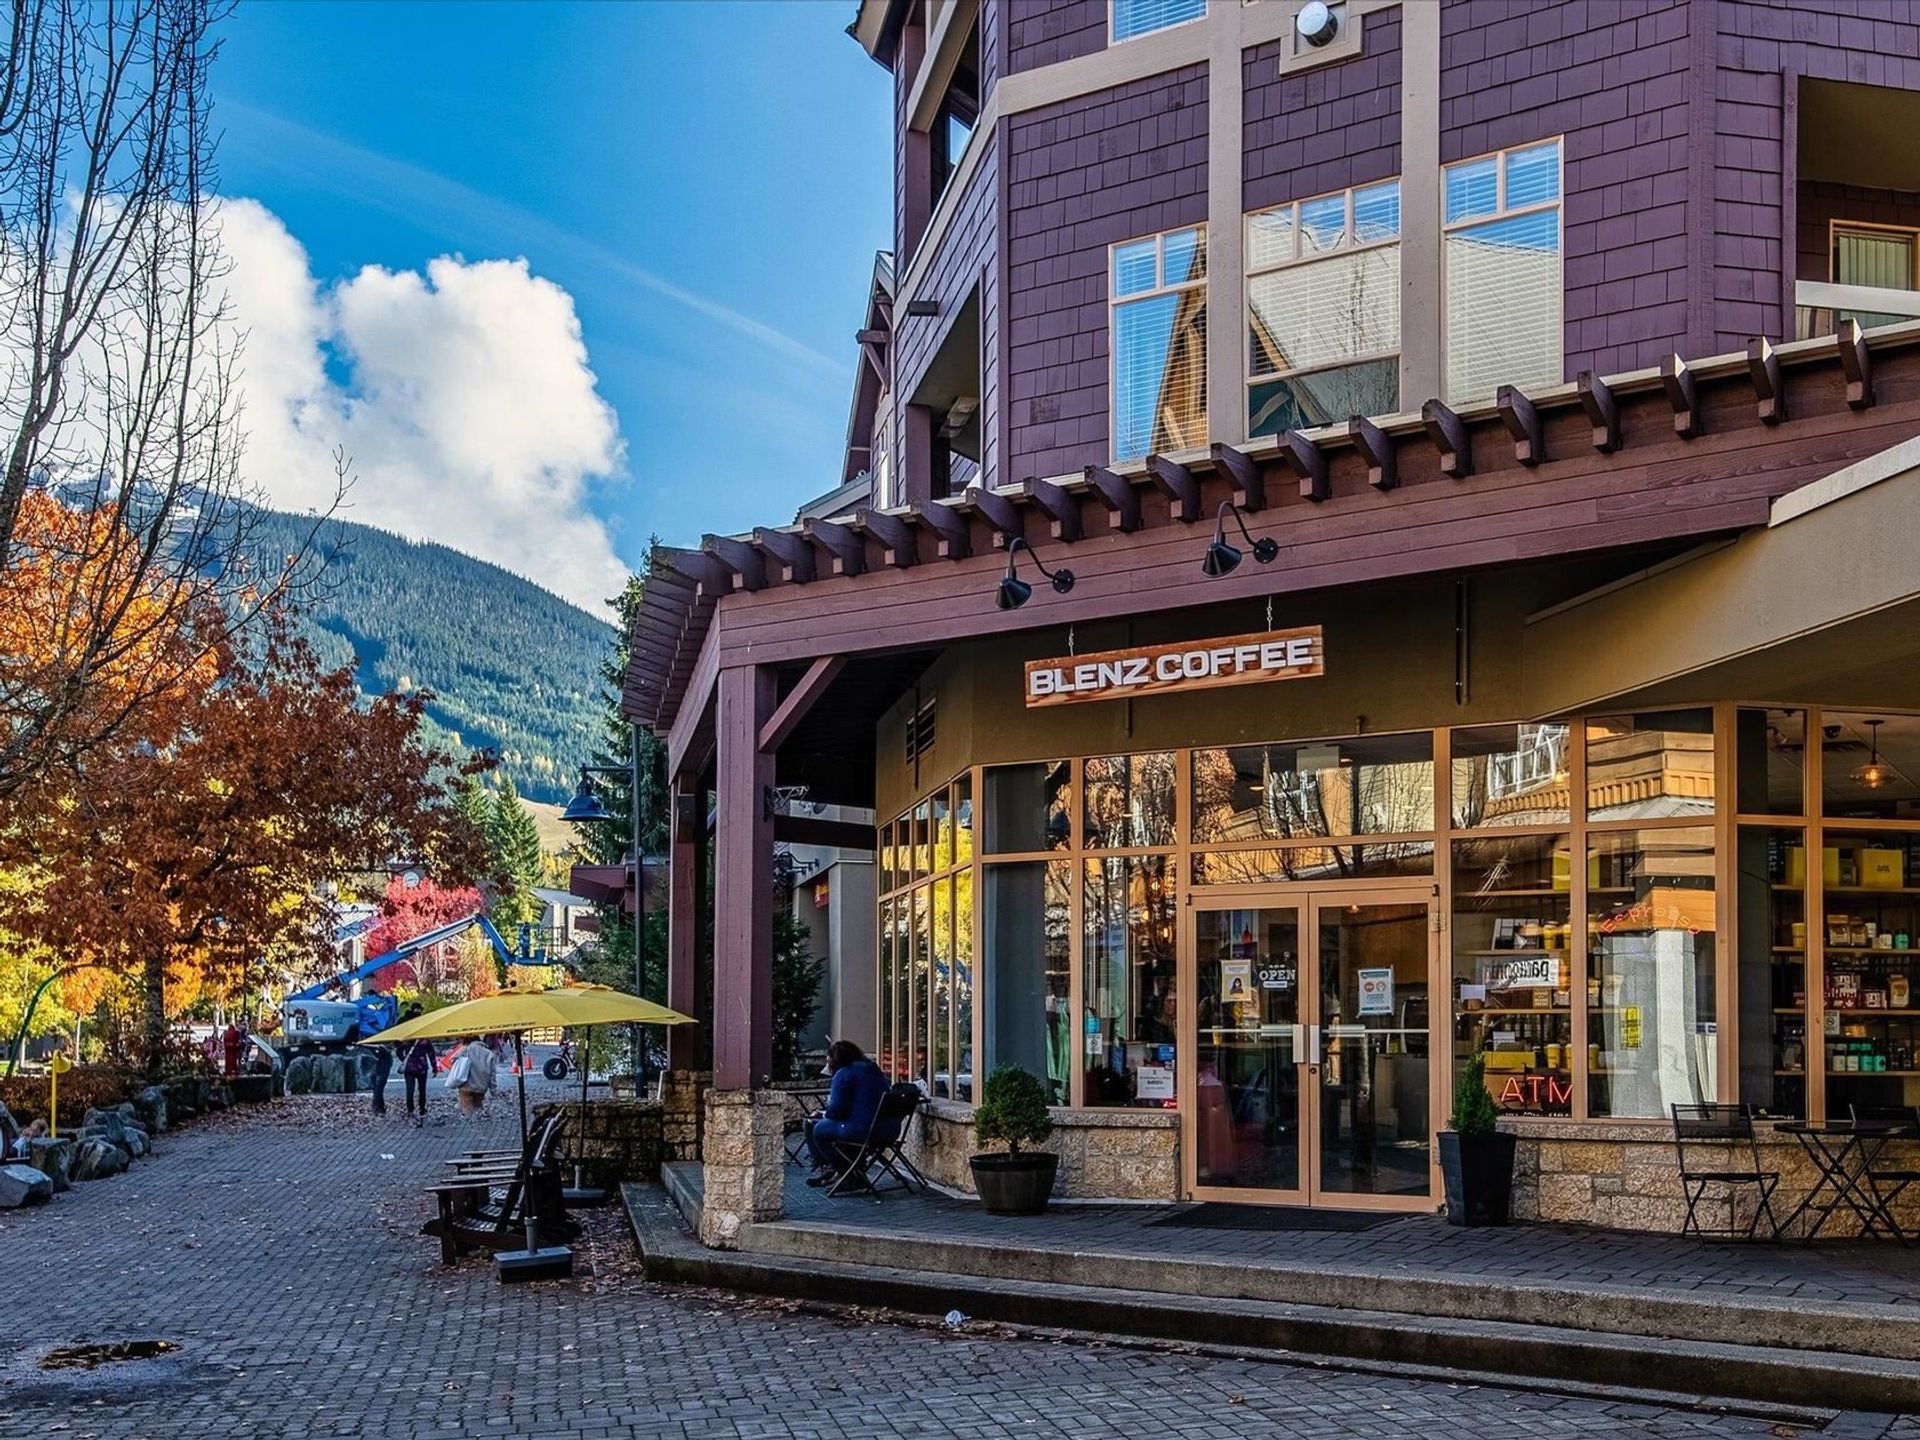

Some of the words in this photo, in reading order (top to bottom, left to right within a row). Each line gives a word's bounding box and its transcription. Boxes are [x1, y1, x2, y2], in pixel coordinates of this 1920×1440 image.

[1030, 658, 1150, 695] BLENZ
[1156, 638, 1313, 681] COFFEE
[1259, 970, 1296, 981] OPEN
[1501, 1076, 1573, 1103] ATM
